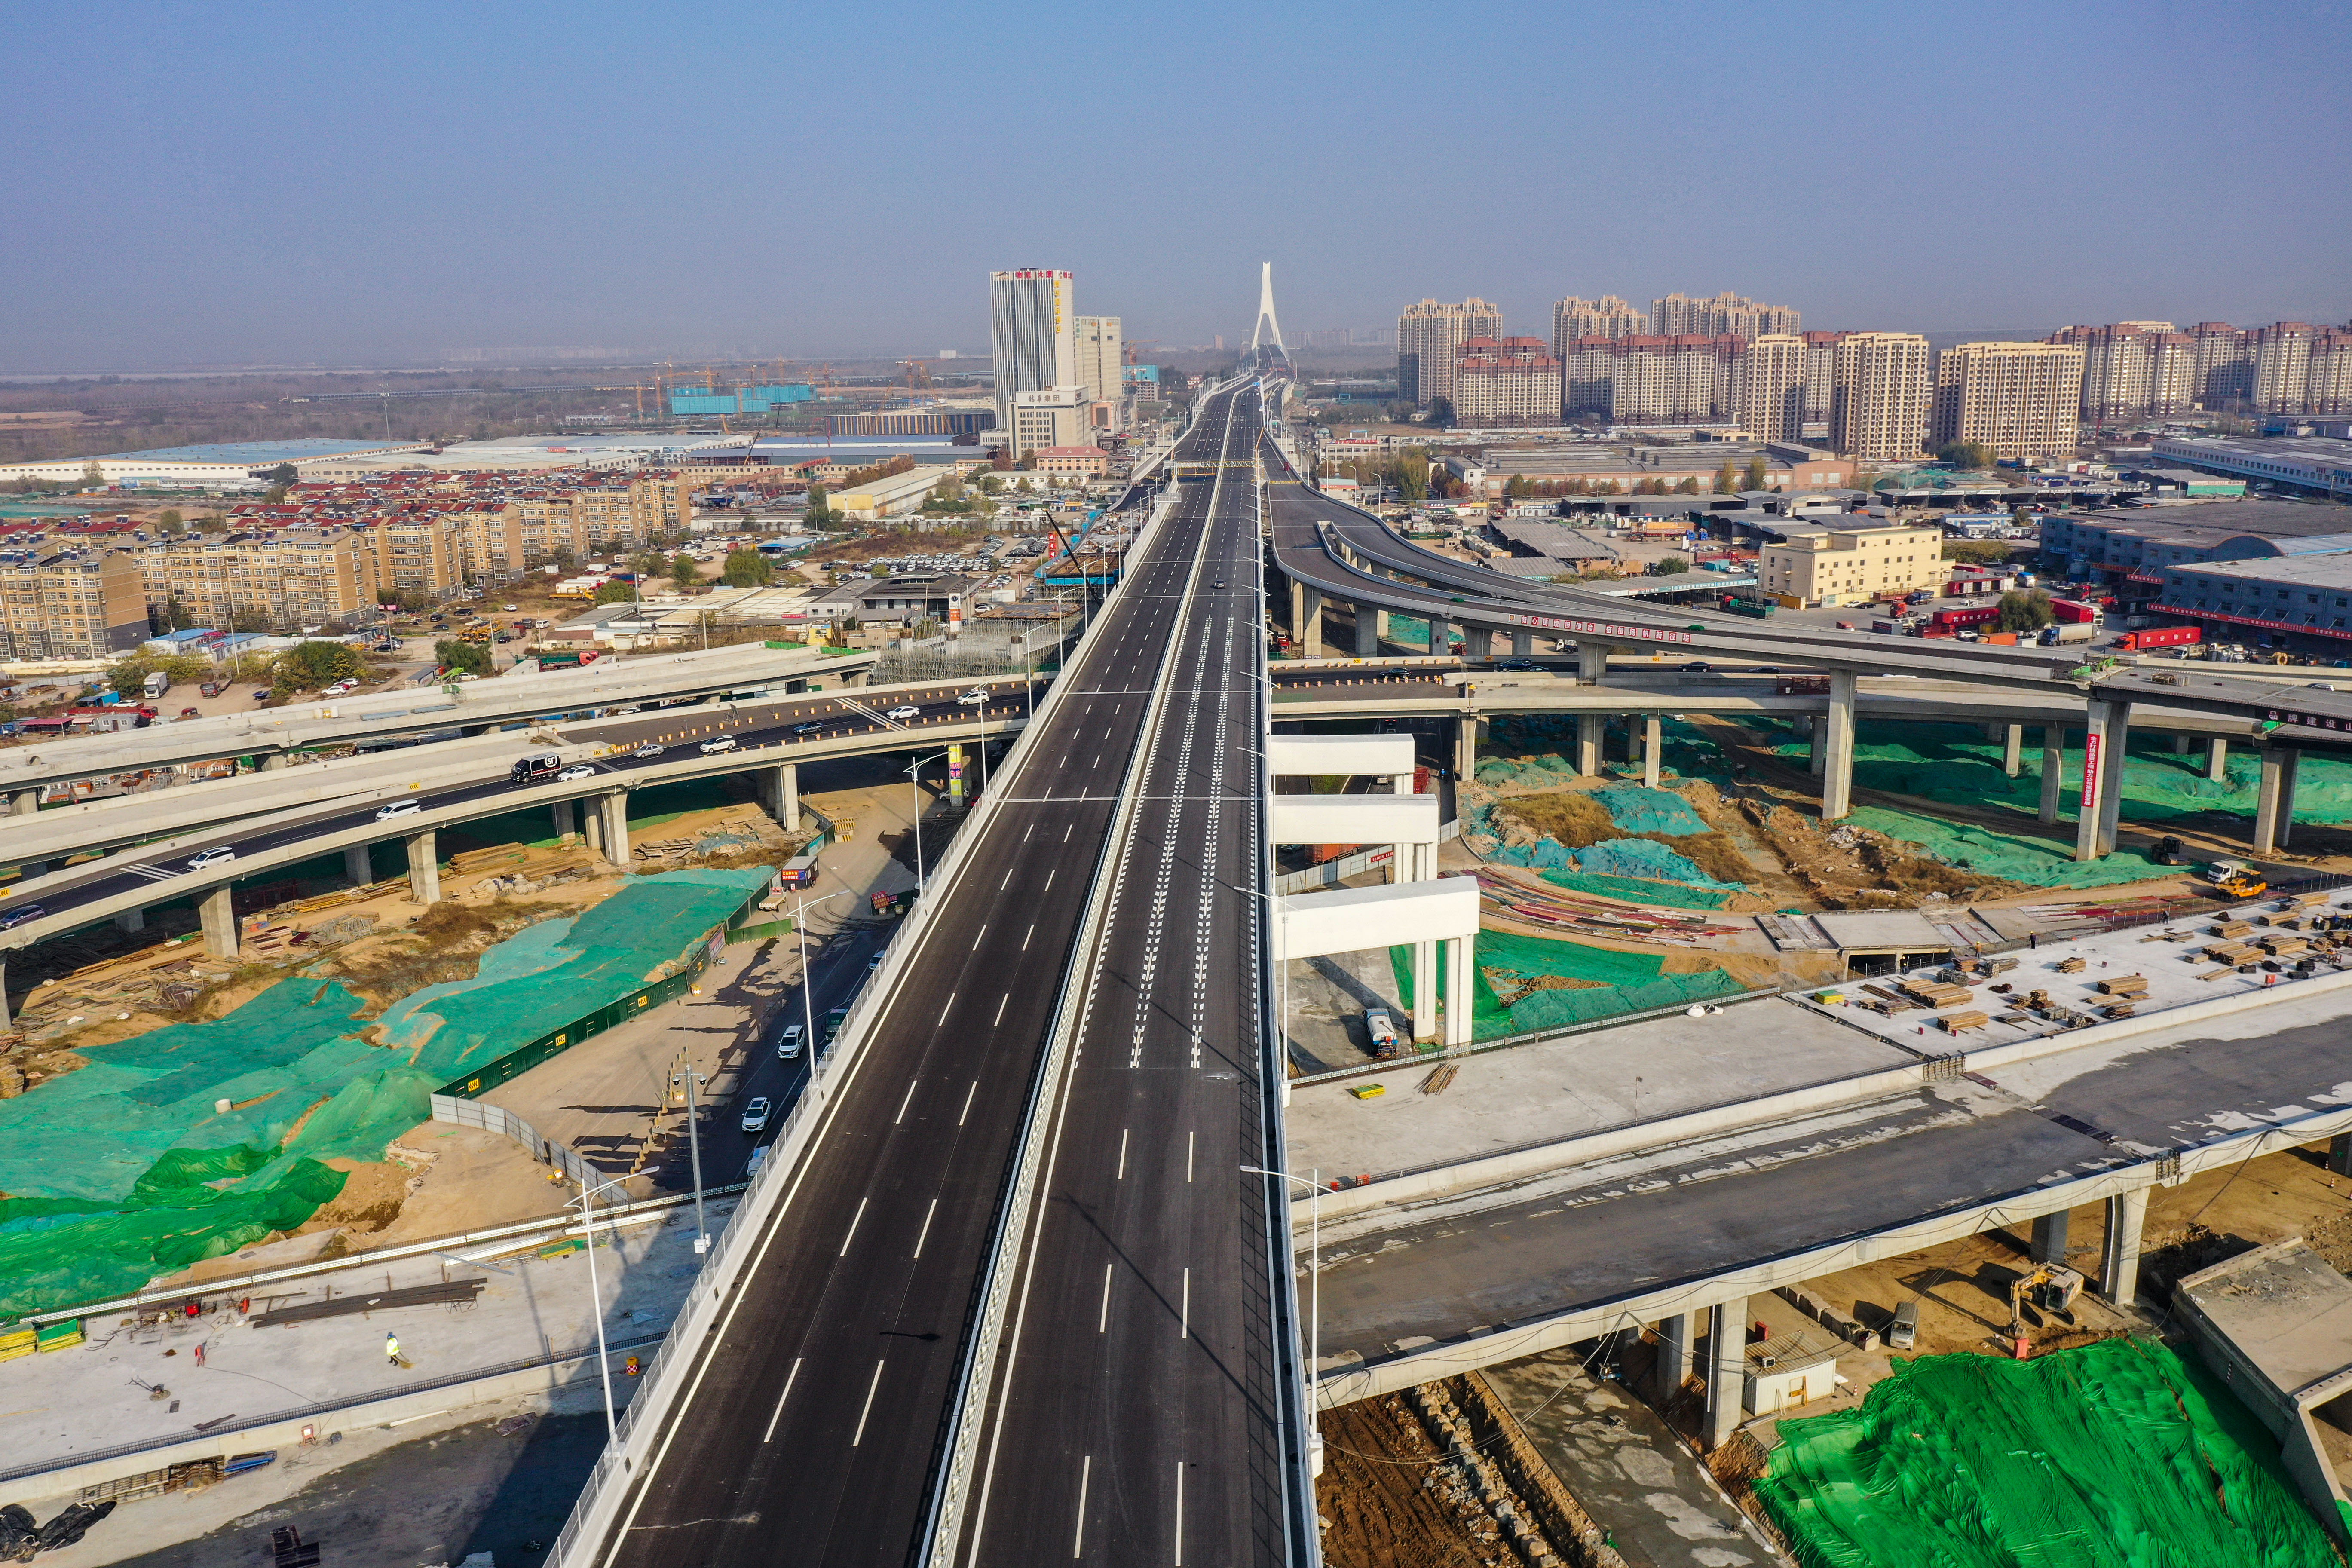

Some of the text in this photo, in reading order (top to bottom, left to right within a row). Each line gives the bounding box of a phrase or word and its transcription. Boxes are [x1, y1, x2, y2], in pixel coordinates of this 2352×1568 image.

[1522, 616, 1690, 642] 凝心铸魂担使命 奋楫扬帆新征程
[2084, 736, 2097, 805] 全力打造品质工程 助力公司高质量发展
